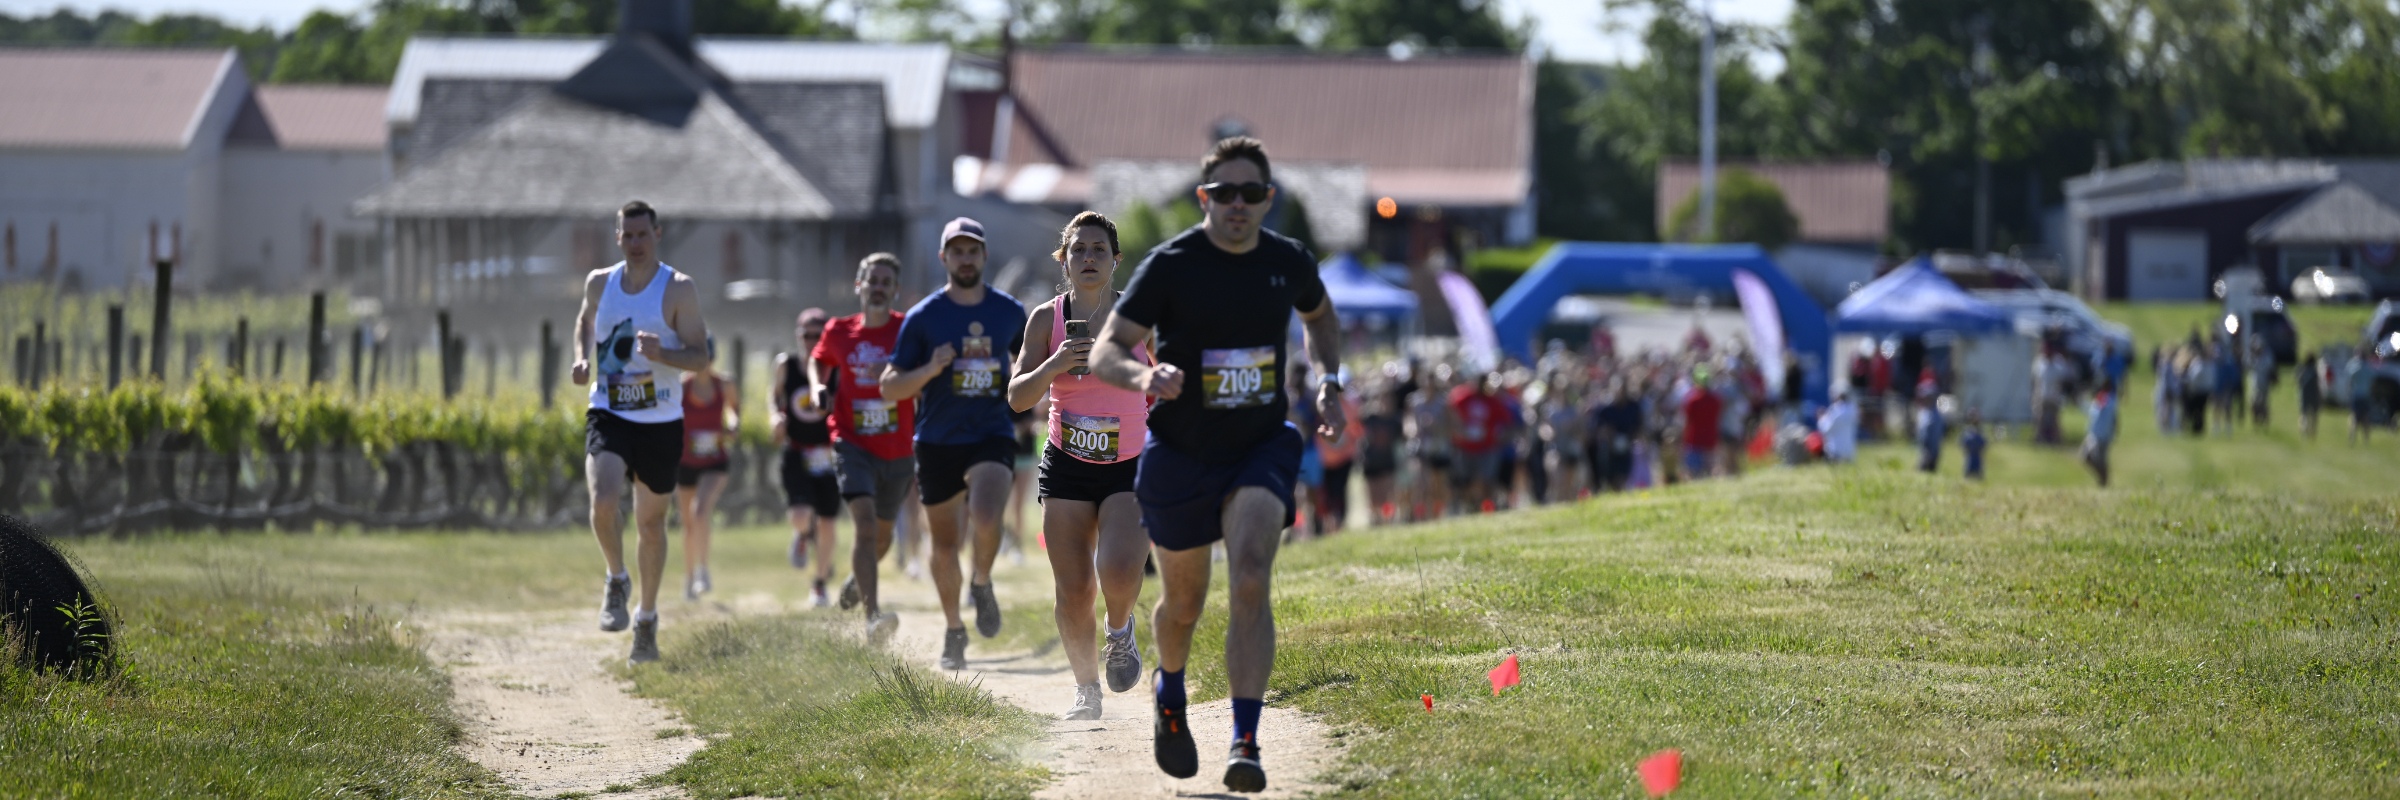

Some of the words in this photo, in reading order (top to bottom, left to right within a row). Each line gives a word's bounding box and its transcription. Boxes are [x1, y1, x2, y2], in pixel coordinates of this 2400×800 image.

[962, 371, 993, 388] 2769
[1217, 368, 1262, 394] 2109
[616, 384, 646, 402] 2801
[1069, 428, 1109, 451] 2000
